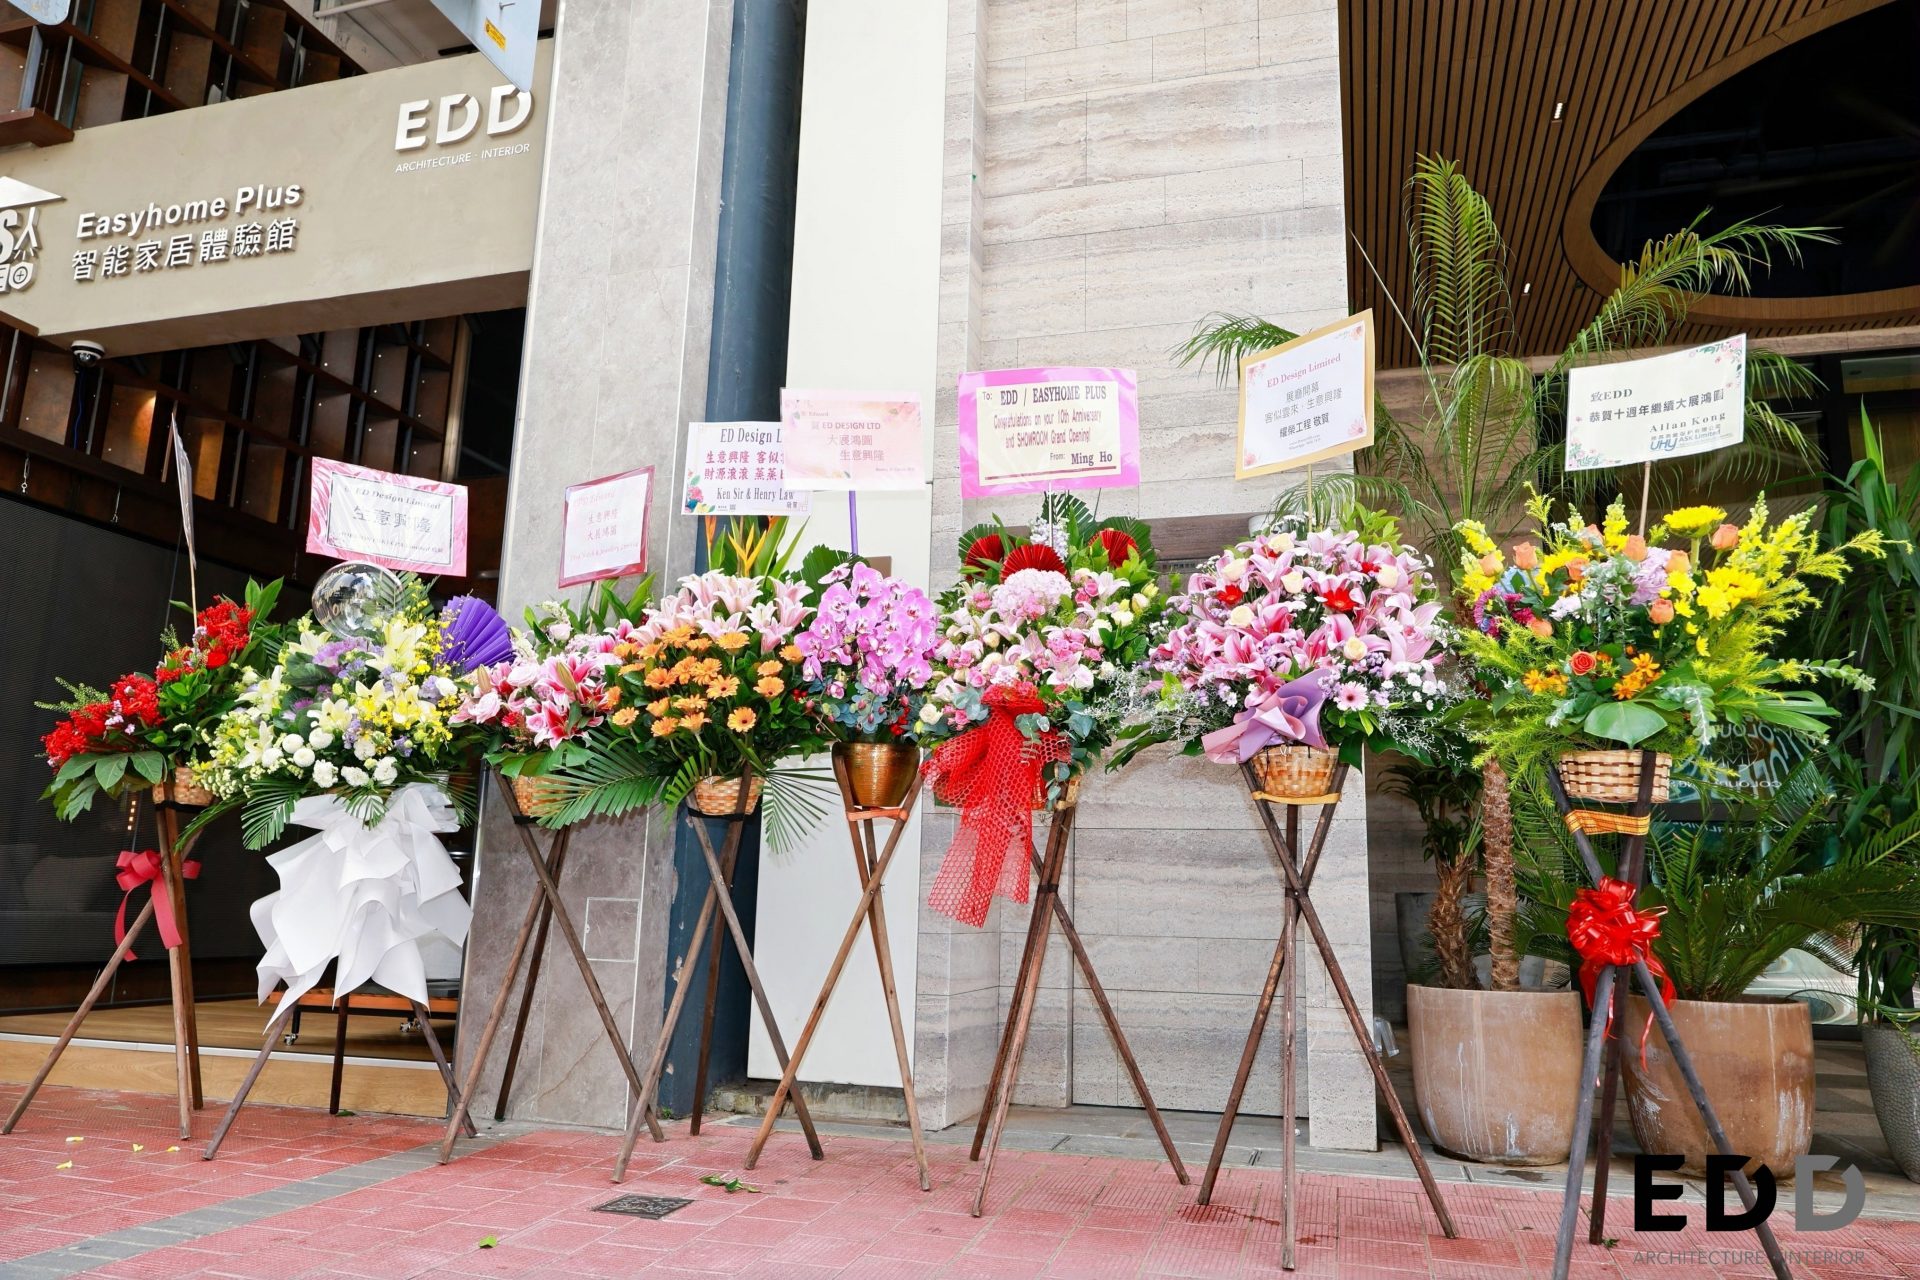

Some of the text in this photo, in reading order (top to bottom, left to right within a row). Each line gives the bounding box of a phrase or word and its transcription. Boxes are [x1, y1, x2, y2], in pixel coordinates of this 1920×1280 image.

[395, 84, 533, 150] EDD
[395, 143, 531, 173] ARCHITECTURE INTERIOR
[76, 184, 301, 239] Easyhome Plus
[71, 217, 298, 281] 智能家居體驗館
[1267, 353, 1341, 388] ED Design Limited
[1000, 389, 1018, 406] EDD
[1033, 385, 1081, 403] EASYHOME
[1085, 385, 1107, 400] PLUS
[835, 422, 864, 430] DESIGN
[867, 422, 881, 430] LTD
[1650, 421, 1687, 432] Allan
[1692, 413, 1726, 425] Kong
[720, 428, 735, 443] ED
[737, 428, 772, 445] Design
[1051, 429, 1066, 444] Grand
[705, 450, 750, 464] 生意興隆
[1071, 452, 1094, 466] Ming
[1100, 451, 1113, 463] Ho
[704, 467, 749, 481] 財源滾滾
[717, 487, 730, 500] Ken
[733, 487, 744, 500] Sir
[754, 487, 776, 502] Henry
[779, 487, 794, 500] Law
